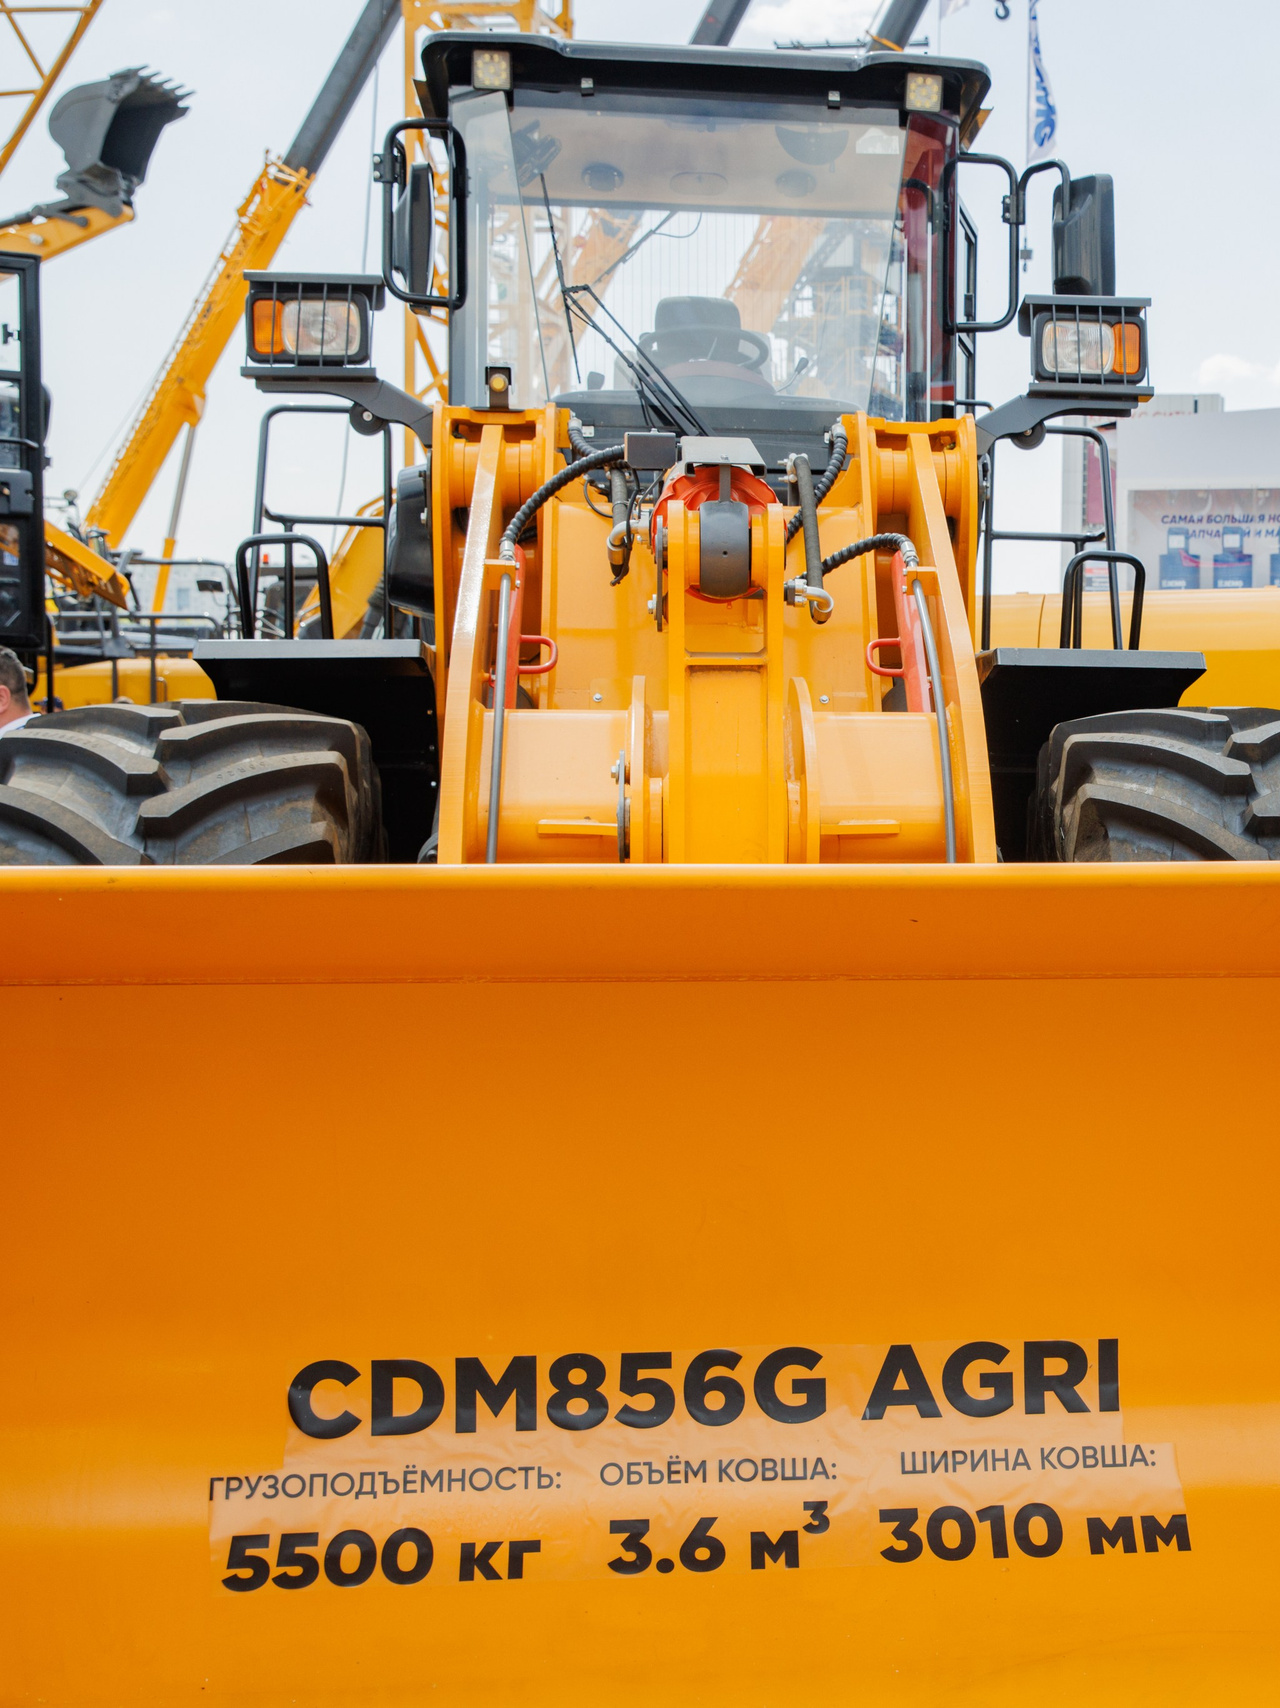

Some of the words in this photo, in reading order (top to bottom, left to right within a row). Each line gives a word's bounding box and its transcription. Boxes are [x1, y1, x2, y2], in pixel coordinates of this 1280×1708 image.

[1181, 526, 1251, 539] АПЧАЙ
[287, 1346, 829, 1440] CDM856G
[860, 1338, 1121, 1421] AGRI
[208, 1464, 562, 1501] ГРУЗОПОДЪЁМНОСТЬ:
[600, 1455, 708, 1487] ОБЪЁМ
[718, 1456, 838, 1483] КОВША:
[900, 1447, 1032, 1475] ШИРИНА
[1040, 1443, 1157, 1471] КОВША:
[607, 1516, 726, 1575] 3.6
[878, 1502, 1064, 1564] 3010
[1086, 1513, 1192, 1555] мм
[221, 1527, 434, 1592] 5500
[458, 1539, 542, 1582] кг
